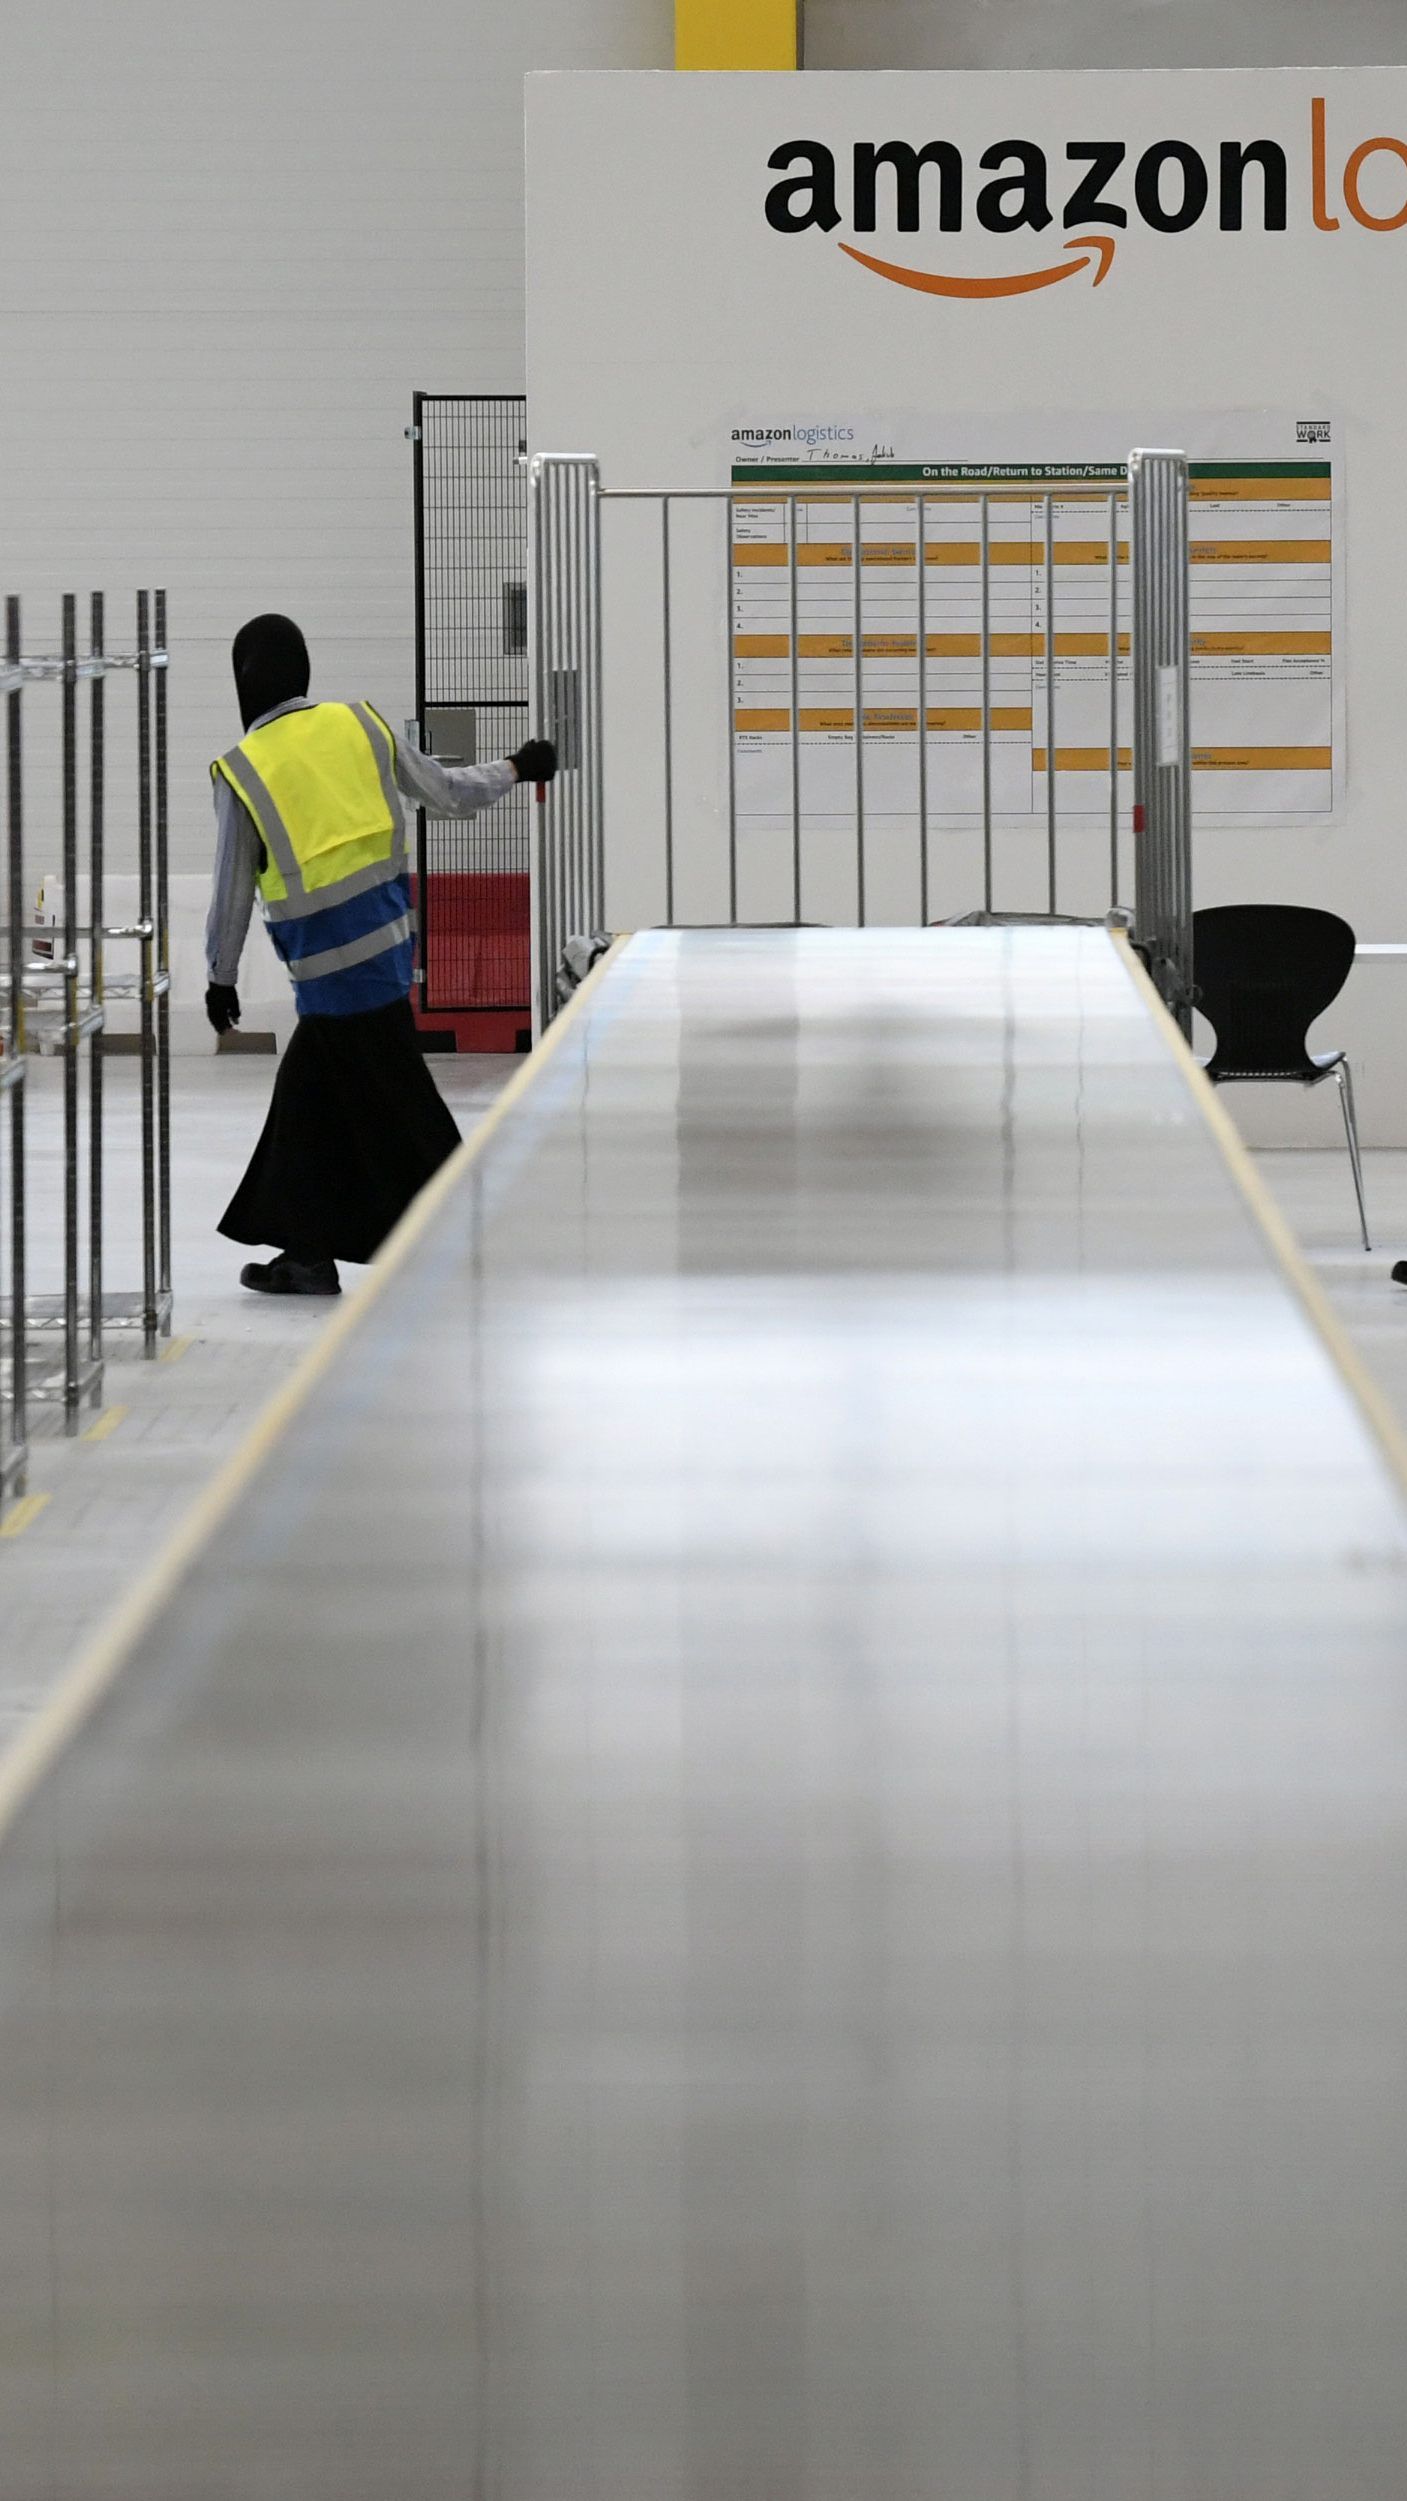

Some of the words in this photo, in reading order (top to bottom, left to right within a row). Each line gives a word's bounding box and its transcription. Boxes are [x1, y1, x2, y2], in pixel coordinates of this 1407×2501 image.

[766, 455, 800, 463] Presenter
[922, 466, 938, 477] On
[941, 466, 958, 477] the
[961, 465, 1029, 478] Road/Return
[1030, 466, 1042, 477] to
[1044, 465, 1118, 478] Station/Same
[1120, 466, 1128, 476] D
